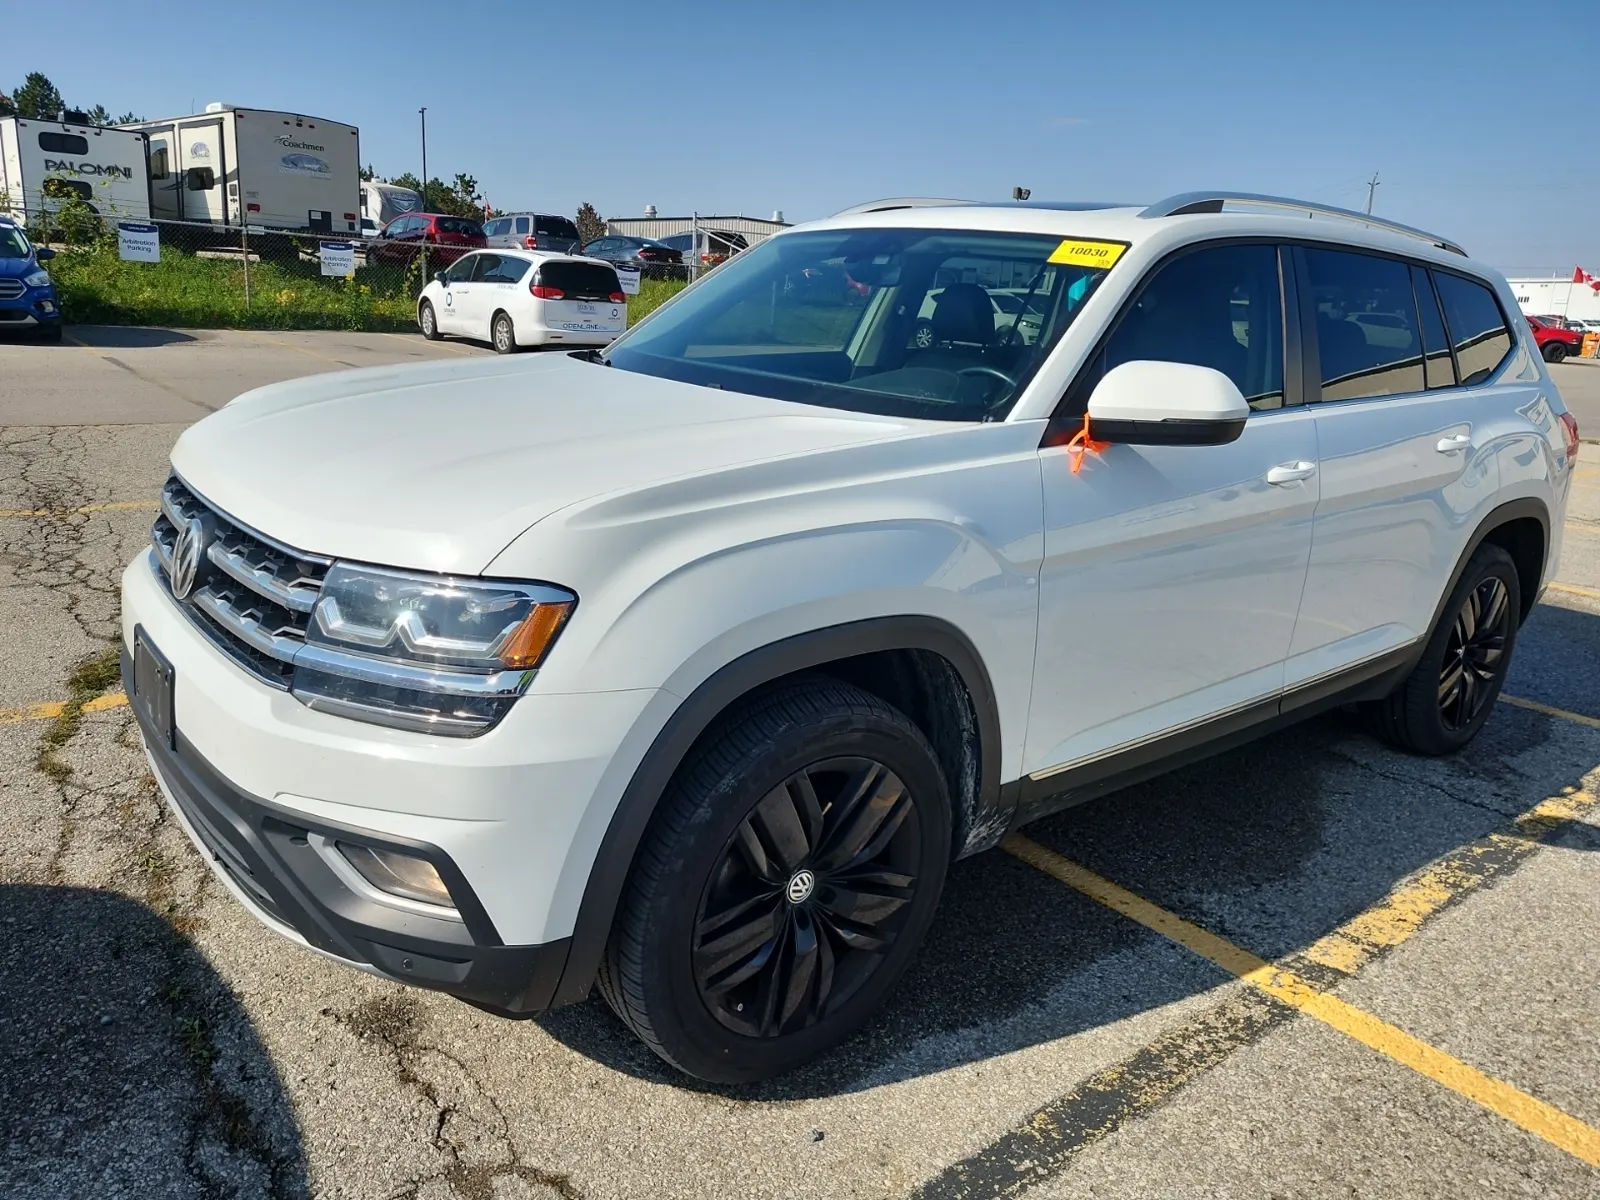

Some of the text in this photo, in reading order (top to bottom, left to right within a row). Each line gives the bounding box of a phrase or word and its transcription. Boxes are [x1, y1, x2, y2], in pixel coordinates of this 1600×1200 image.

[282, 139, 325, 152] Coachmen
[122, 238, 156, 247] Arbitration
[127, 244, 152, 253] Parking
[1069, 247, 1109, 257] 10030
